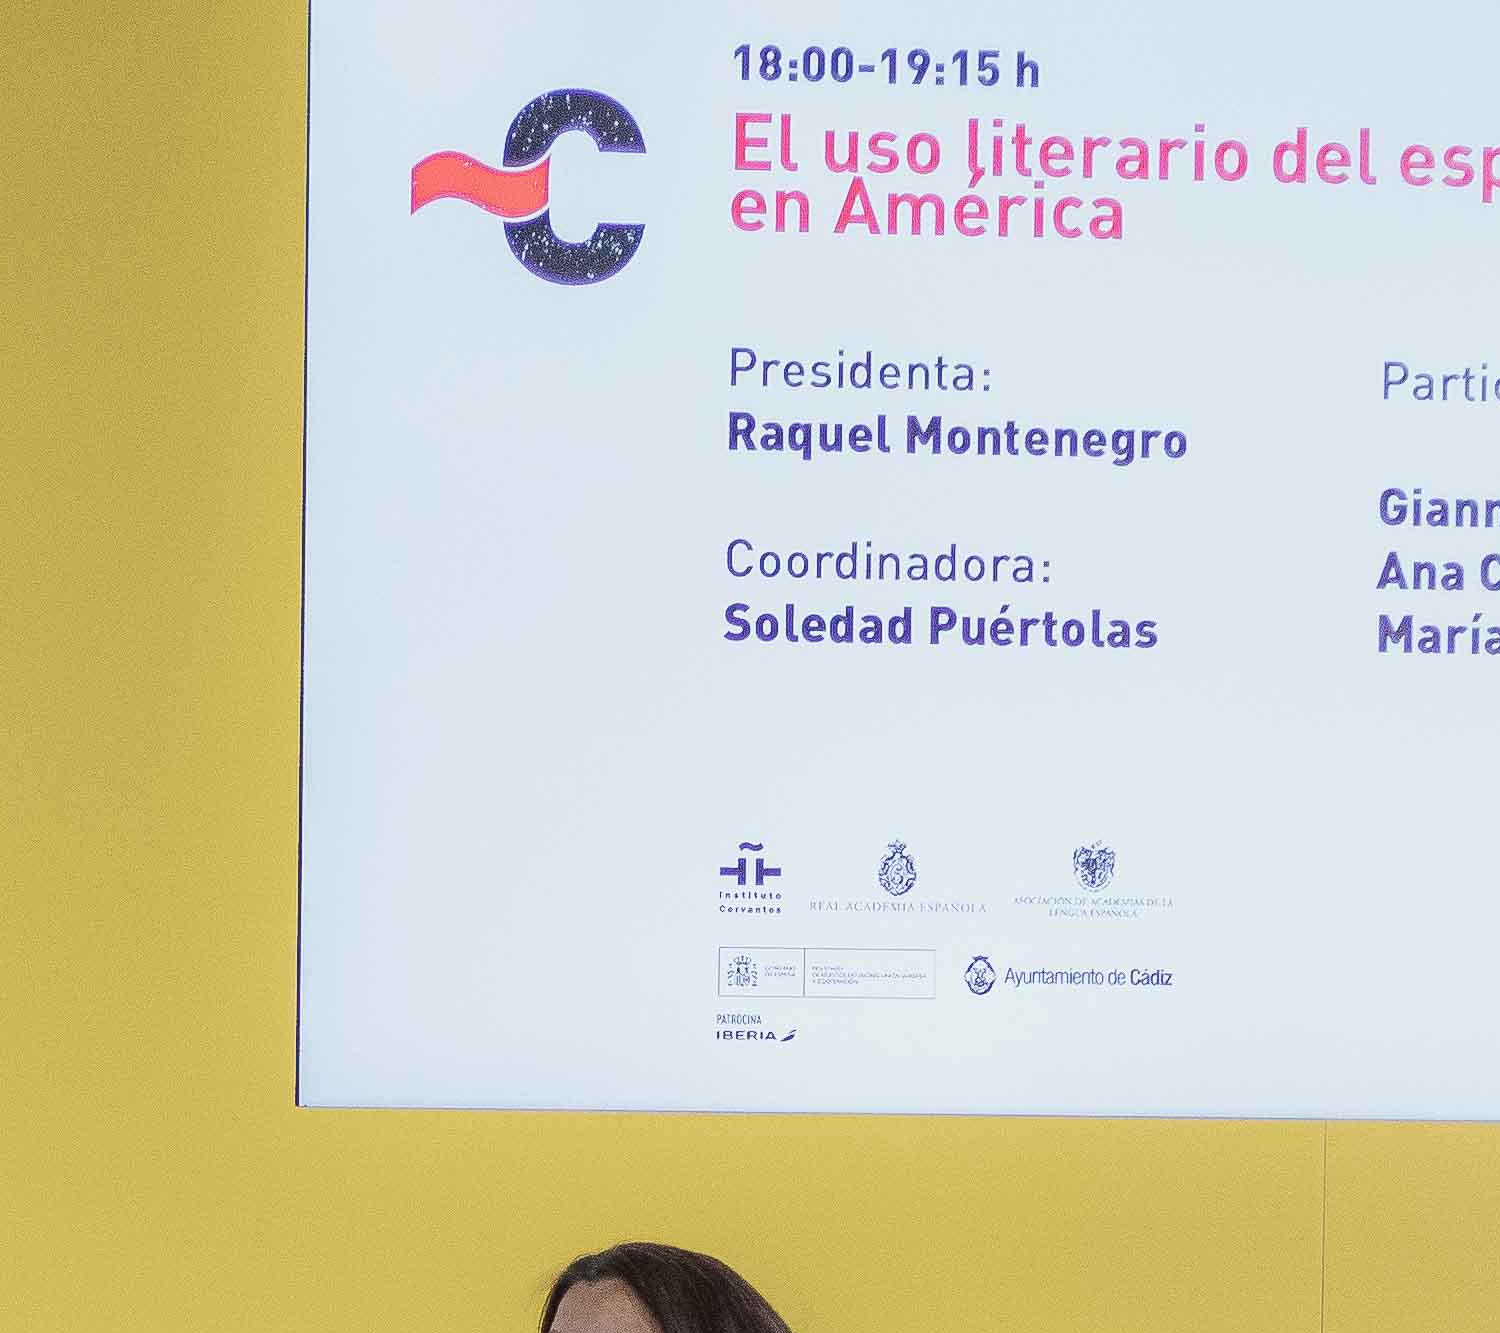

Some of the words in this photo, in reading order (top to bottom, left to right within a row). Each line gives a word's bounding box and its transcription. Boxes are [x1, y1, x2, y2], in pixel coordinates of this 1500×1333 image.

[734, 44, 1000, 86] 18:00-19:15
[1016, 51, 1039, 87] h
[735, 113, 798, 171] El
[824, 129, 941, 176] uso
[967, 118, 1249, 183] literario
[1273, 127, 1376, 185] del
[731, 189, 810, 232] en
[833, 177, 1125, 241] América
[731, 348, 990, 391] Presidenta:
[729, 412, 890, 460] Raquel
[907, 415, 1187, 466] Montenegro
[727, 539, 1050, 583] Coordinadora:
[1376, 551, 1464, 591] Ana
[724, 603, 912, 644] Soledad
[930, 604, 1157, 648] Puértolas
[719, 890, 783, 901] Instituto
[719, 904, 783, 915] Cervantes
[1004, 967, 1104, 988] Ayuntamiento
[1107, 968, 1127, 986] de
[1130, 968, 1173, 987] Cádiz
[716, 1014, 762, 1025] PATROCINA
[716, 1030, 777, 1042] IBERIA
